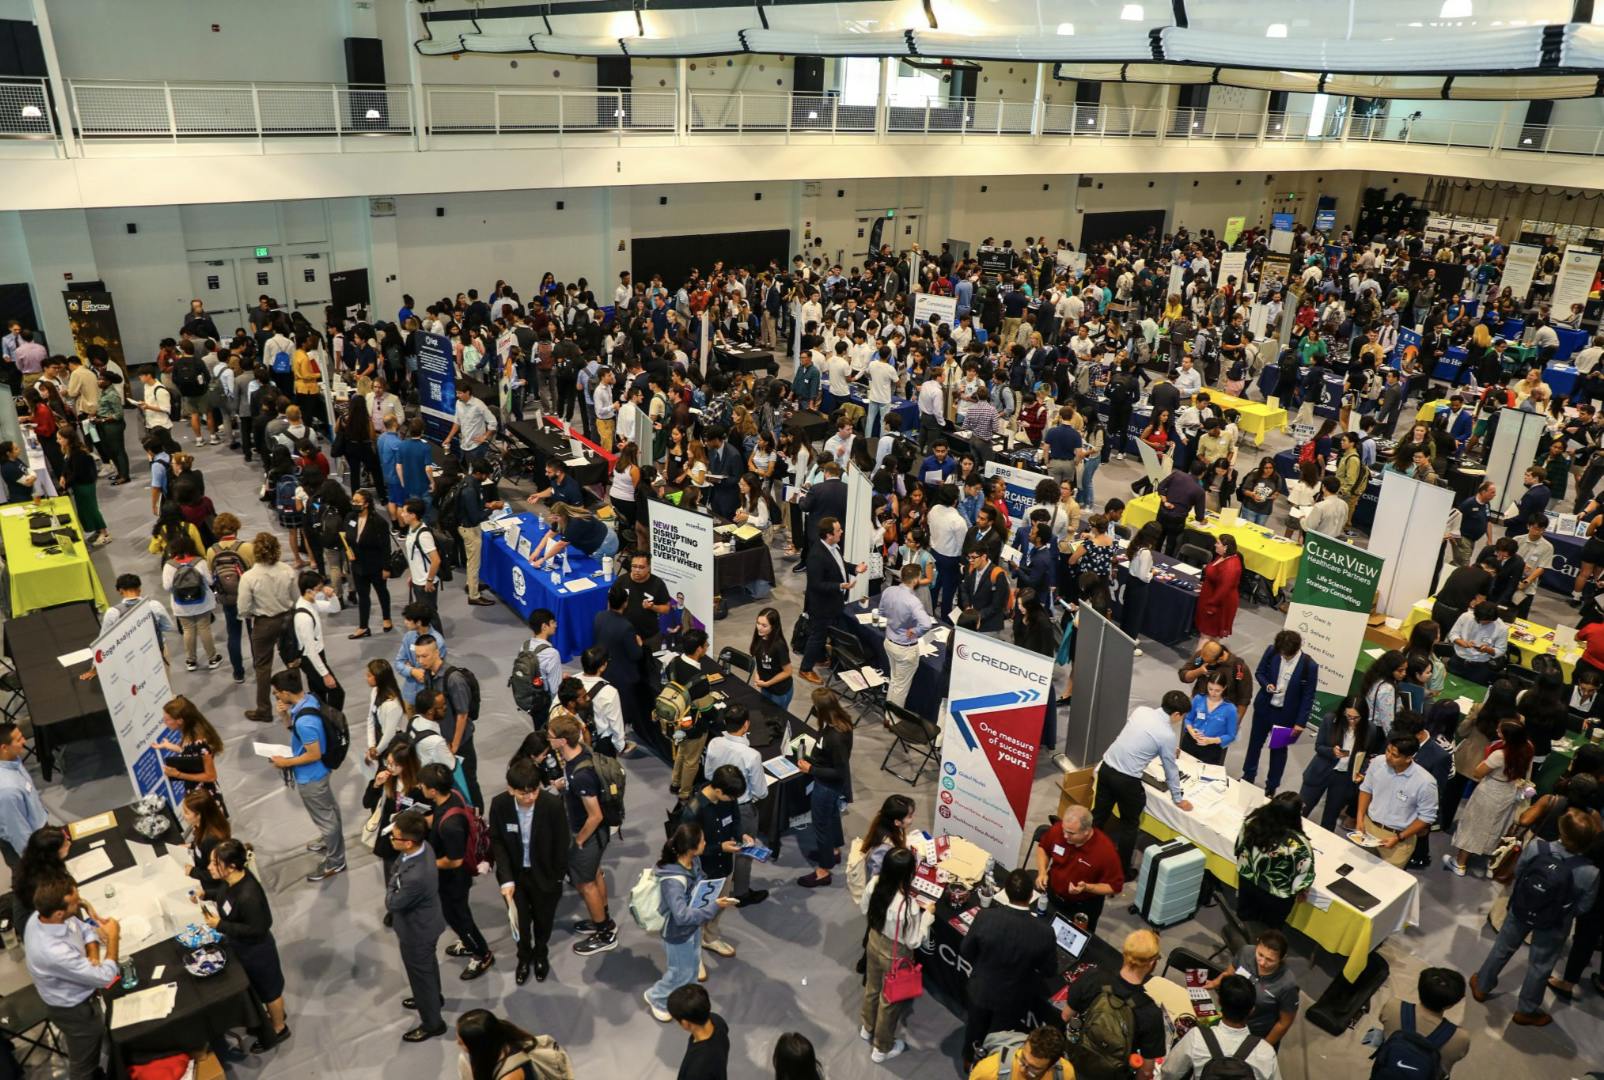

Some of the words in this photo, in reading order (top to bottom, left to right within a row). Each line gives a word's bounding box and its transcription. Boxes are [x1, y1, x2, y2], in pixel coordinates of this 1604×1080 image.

[996, 468, 1011, 477] BRG
[1010, 493, 1038, 506] CAREE
[653, 520, 670, 530] NEW
[671, 525, 678, 533] IS
[653, 528, 698, 547] DISRUPTING
[653, 535, 677, 547] EVERY
[653, 542, 690, 559] INDUSTRY
[653, 549, 703, 571] EVERYWHERE
[1307, 555, 1341, 574] Healthcare
[1342, 568, 1371, 585] Partners
[1306, 578, 1329, 593] Strategy
[1330, 588, 1361, 607] Consulting
[1317, 574, 1328, 583] Life
[1328, 578, 1353, 593] Sciences
[102, 645, 116, 659] Sage
[116, 626, 136, 646] Analysis
[971, 651, 1048, 686] CREDENCE
[980, 722, 997, 736] One
[999, 732, 1034, 751] measure
[988, 737, 998, 745] of
[1000, 742, 1032, 760] success:
[998, 751, 1030, 770] yours.
